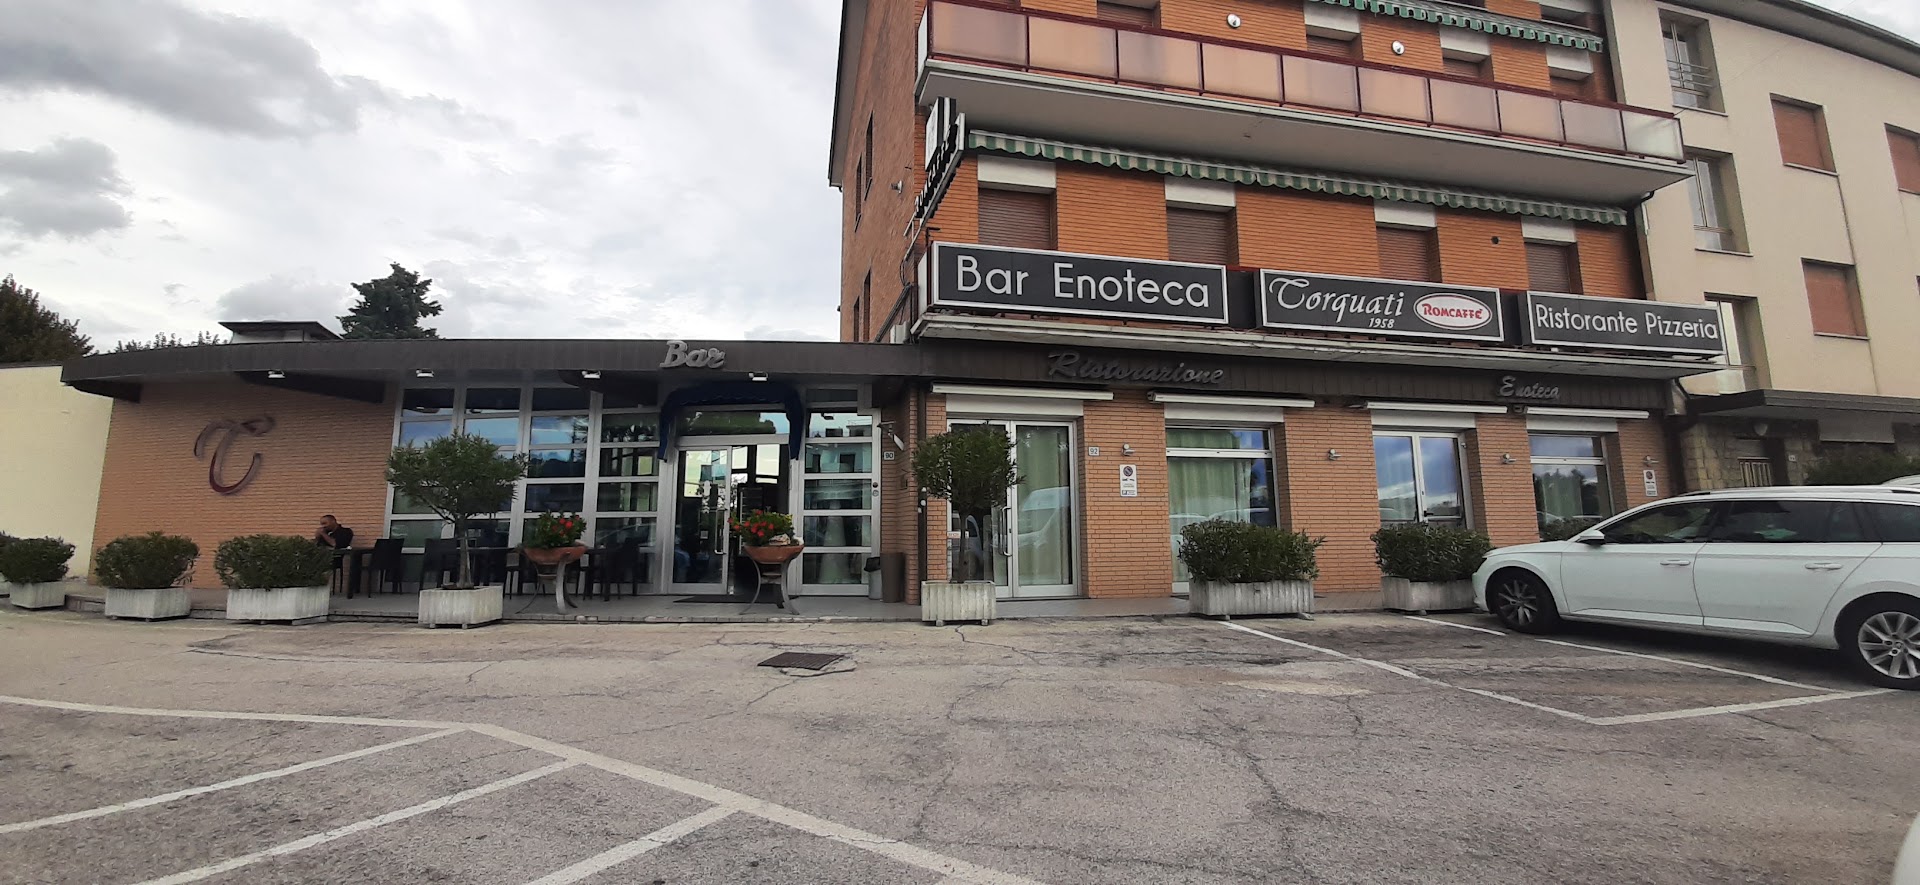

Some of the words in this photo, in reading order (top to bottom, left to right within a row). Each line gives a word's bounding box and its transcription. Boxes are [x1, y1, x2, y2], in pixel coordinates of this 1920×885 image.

[957, 255, 1029, 295] Bar
[1053, 262, 1209, 308] Enoteca
[1269, 277, 1405, 323] Torquati
[1368, 317, 1395, 329] 1958
[1535, 303, 1638, 334] Ristorante
[1645, 312, 1718, 339] Pizzeria
[660, 340, 725, 368] Bar
[1048, 352, 1224, 384] Ristorazione
[1500, 375, 1559, 399] Enoteca
[1089, 447, 1098, 455] 92
